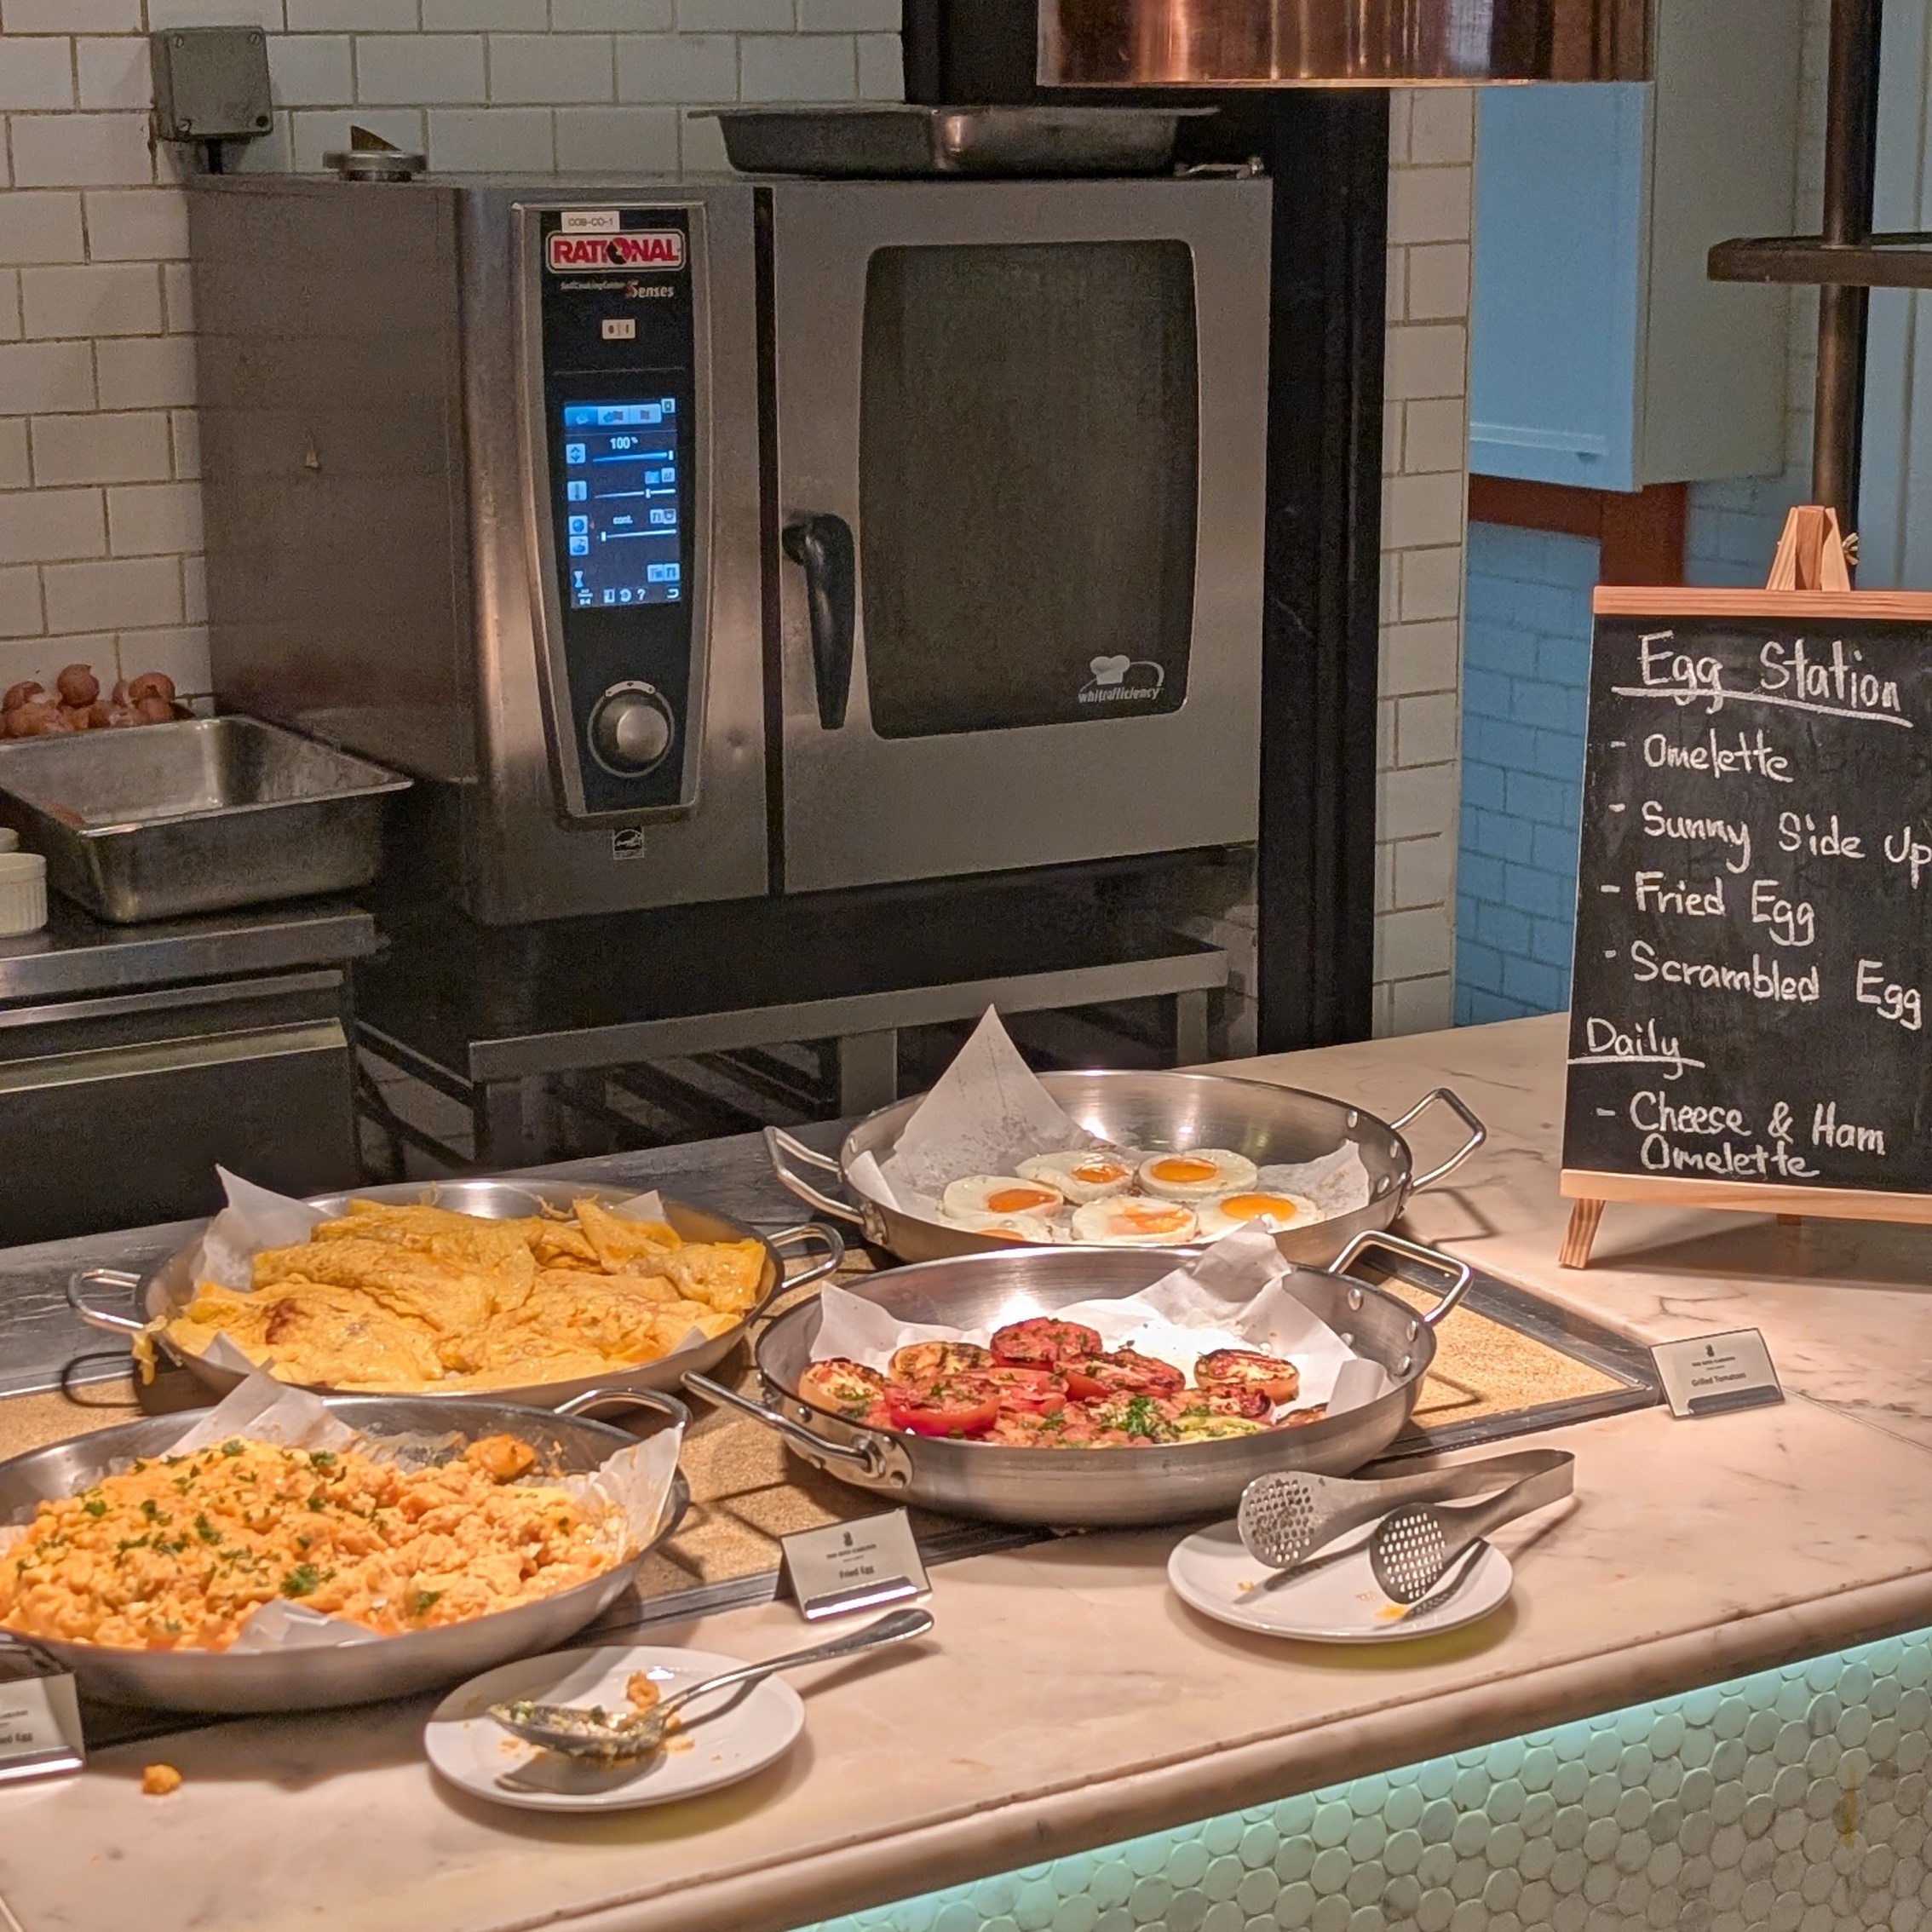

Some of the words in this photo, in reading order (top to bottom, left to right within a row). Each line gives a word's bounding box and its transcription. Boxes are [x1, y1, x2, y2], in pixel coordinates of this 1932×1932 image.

[554, 237, 680, 266] RATIONAL
[1637, 630, 1723, 714] Egg
[1759, 637, 1901, 712] Station
[1643, 727, 1794, 784] Omelette
[1642, 800, 1751, 874] Sunny
[1778, 812, 1866, 859] Side
[1884, 826, 1932, 890] Up
[1634, 871, 1726, 917] Fried
[1751, 879, 1816, 946] Egg
[1630, 939, 1820, 1003] Scrambled
[1856, 958, 1923, 1031] Egg
[1586, 1016, 1683, 1080] Daily
[1629, 1090, 1752, 1137] Cheese
[1767, 1101, 1794, 1144] &
[1812, 1101, 1886, 1156] Ham
[1640, 1132, 1820, 1177] Omelette
